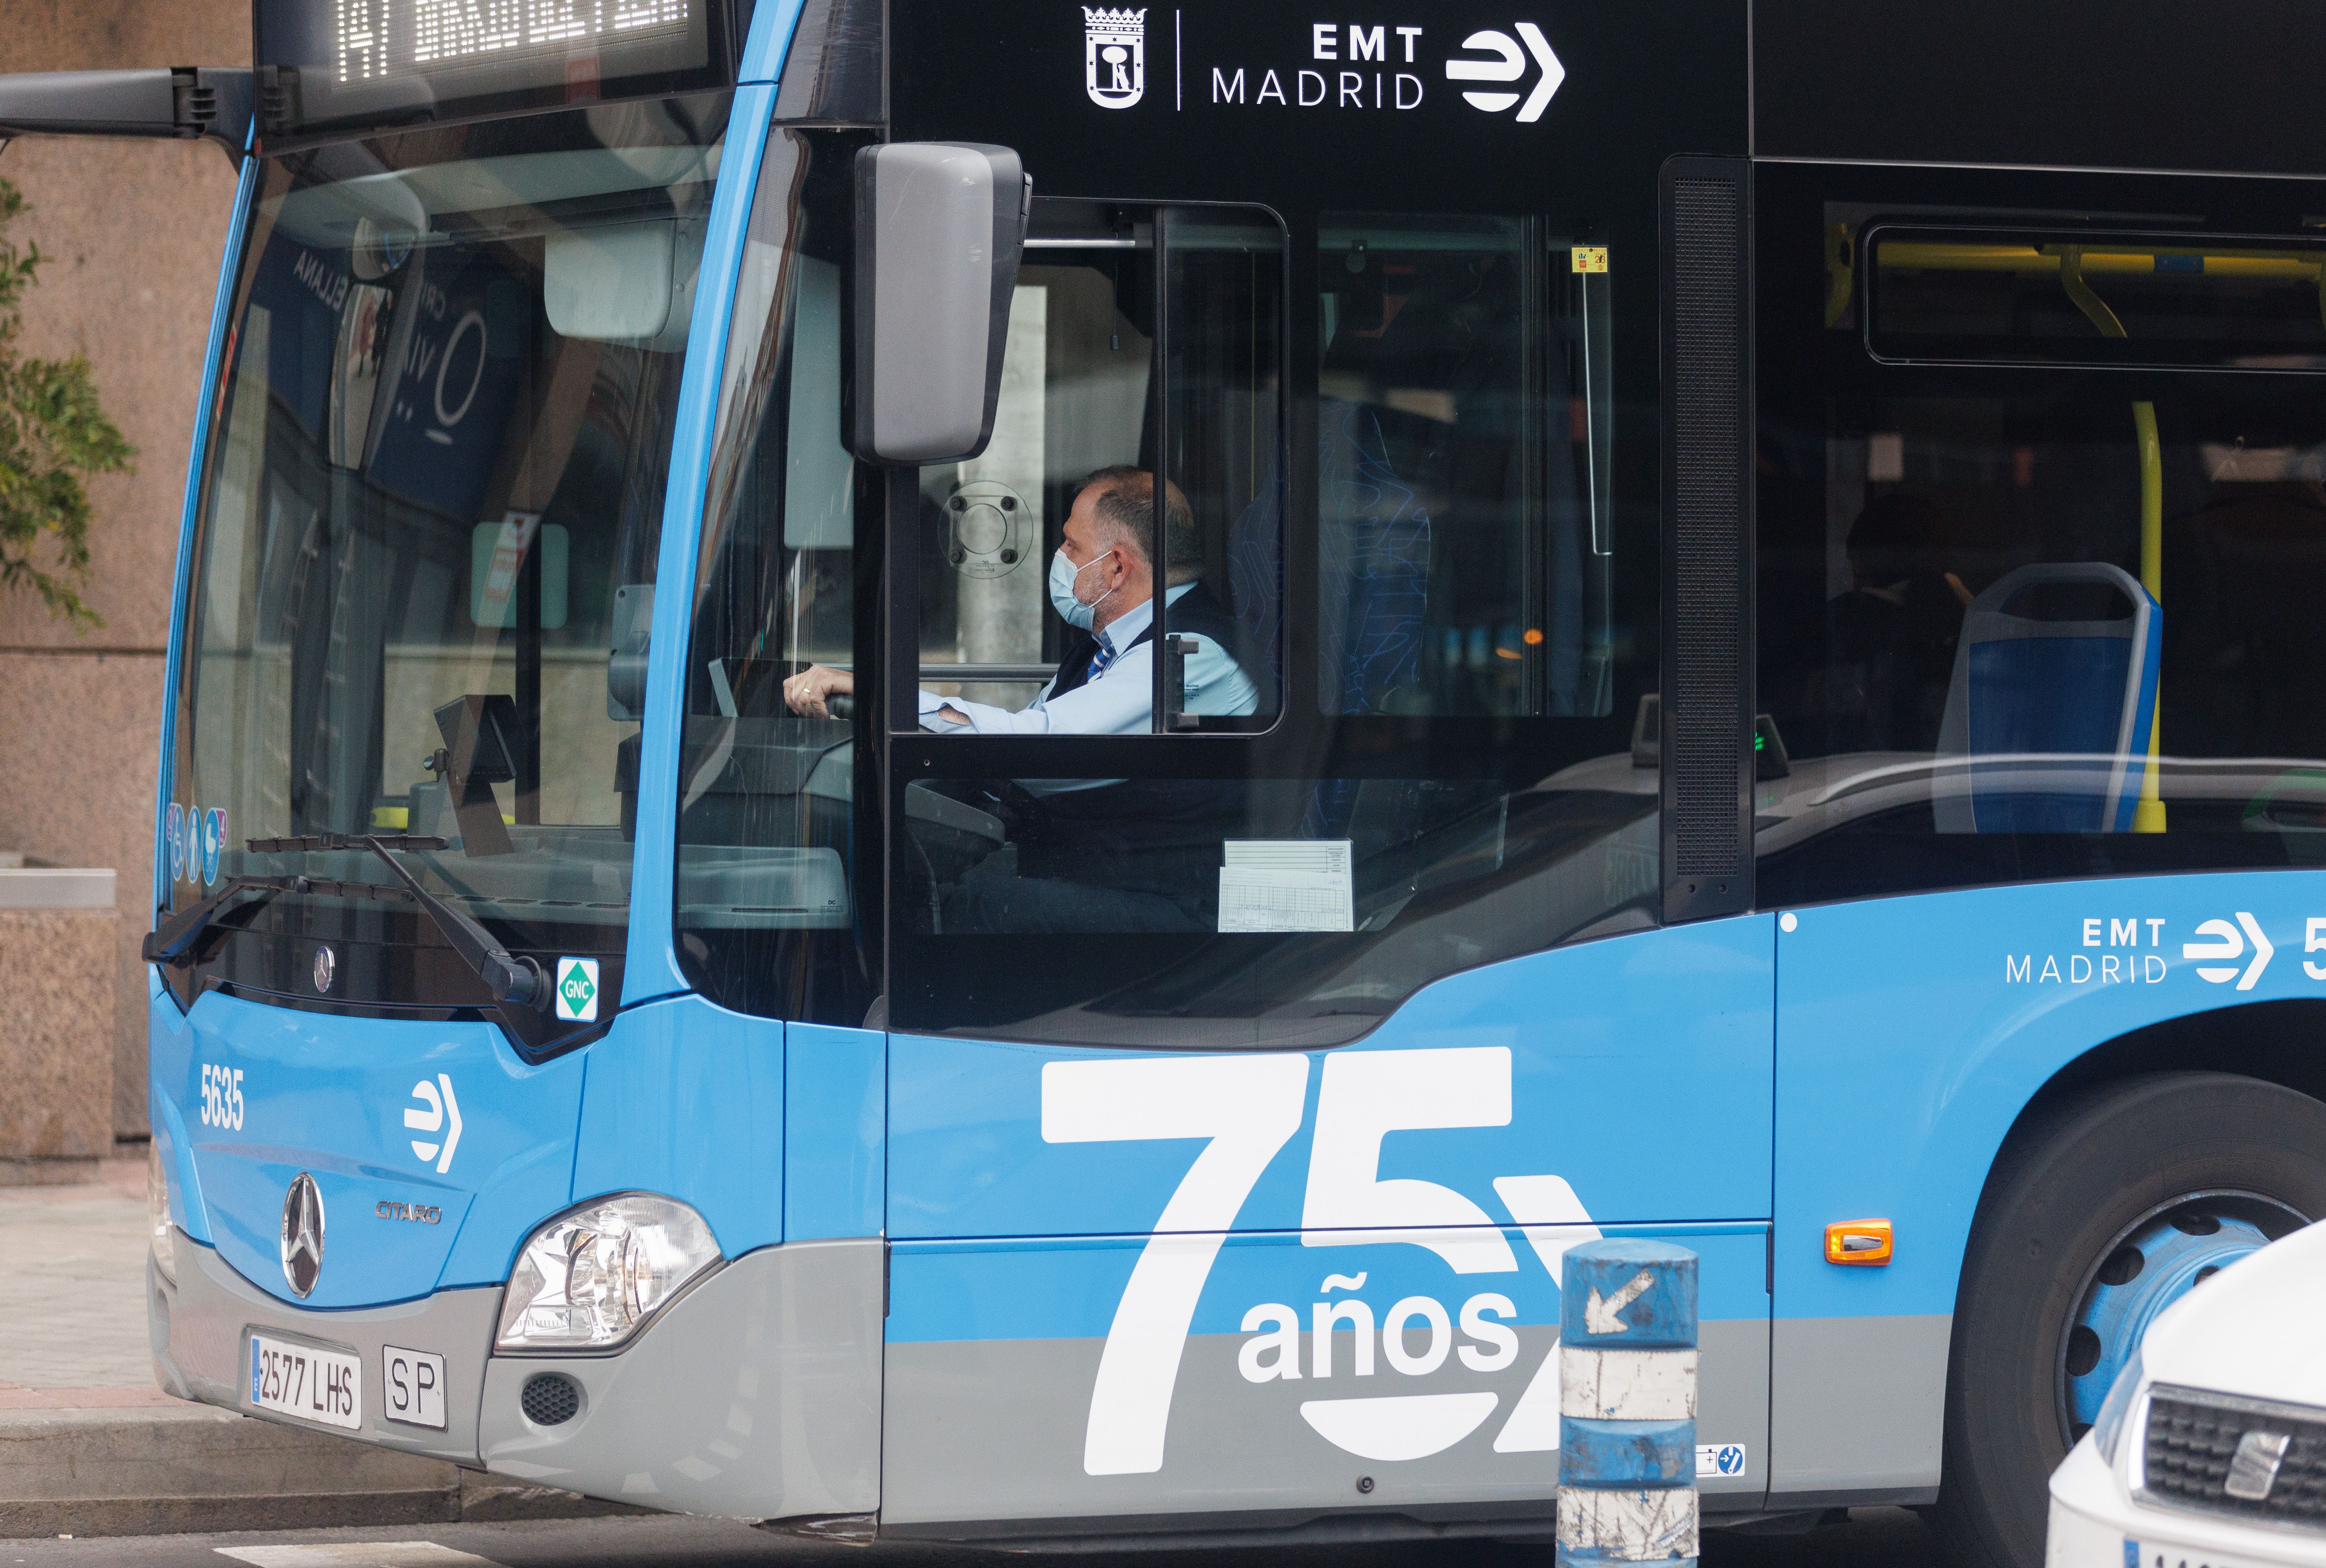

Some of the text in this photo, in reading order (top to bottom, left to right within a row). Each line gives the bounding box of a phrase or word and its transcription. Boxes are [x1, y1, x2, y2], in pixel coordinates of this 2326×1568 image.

[1313, 24, 1422, 63] EMT
[1213, 67, 1423, 110] MADRID
[2083, 918, 2165, 947] EMT
[565, 980, 590, 999] GNC
[2006, 955, 2166, 983] MADRID
[201, 1064, 244, 1131] 5635
[375, 1201, 442, 1225] CITARO
[1041, 1046, 1519, 1476] 75
[1238, 1271, 1519, 1383] años
[262, 1349, 305, 1406] 2577
[313, 1360, 352, 1416] LHS
[392, 1357, 435, 1414] SP
